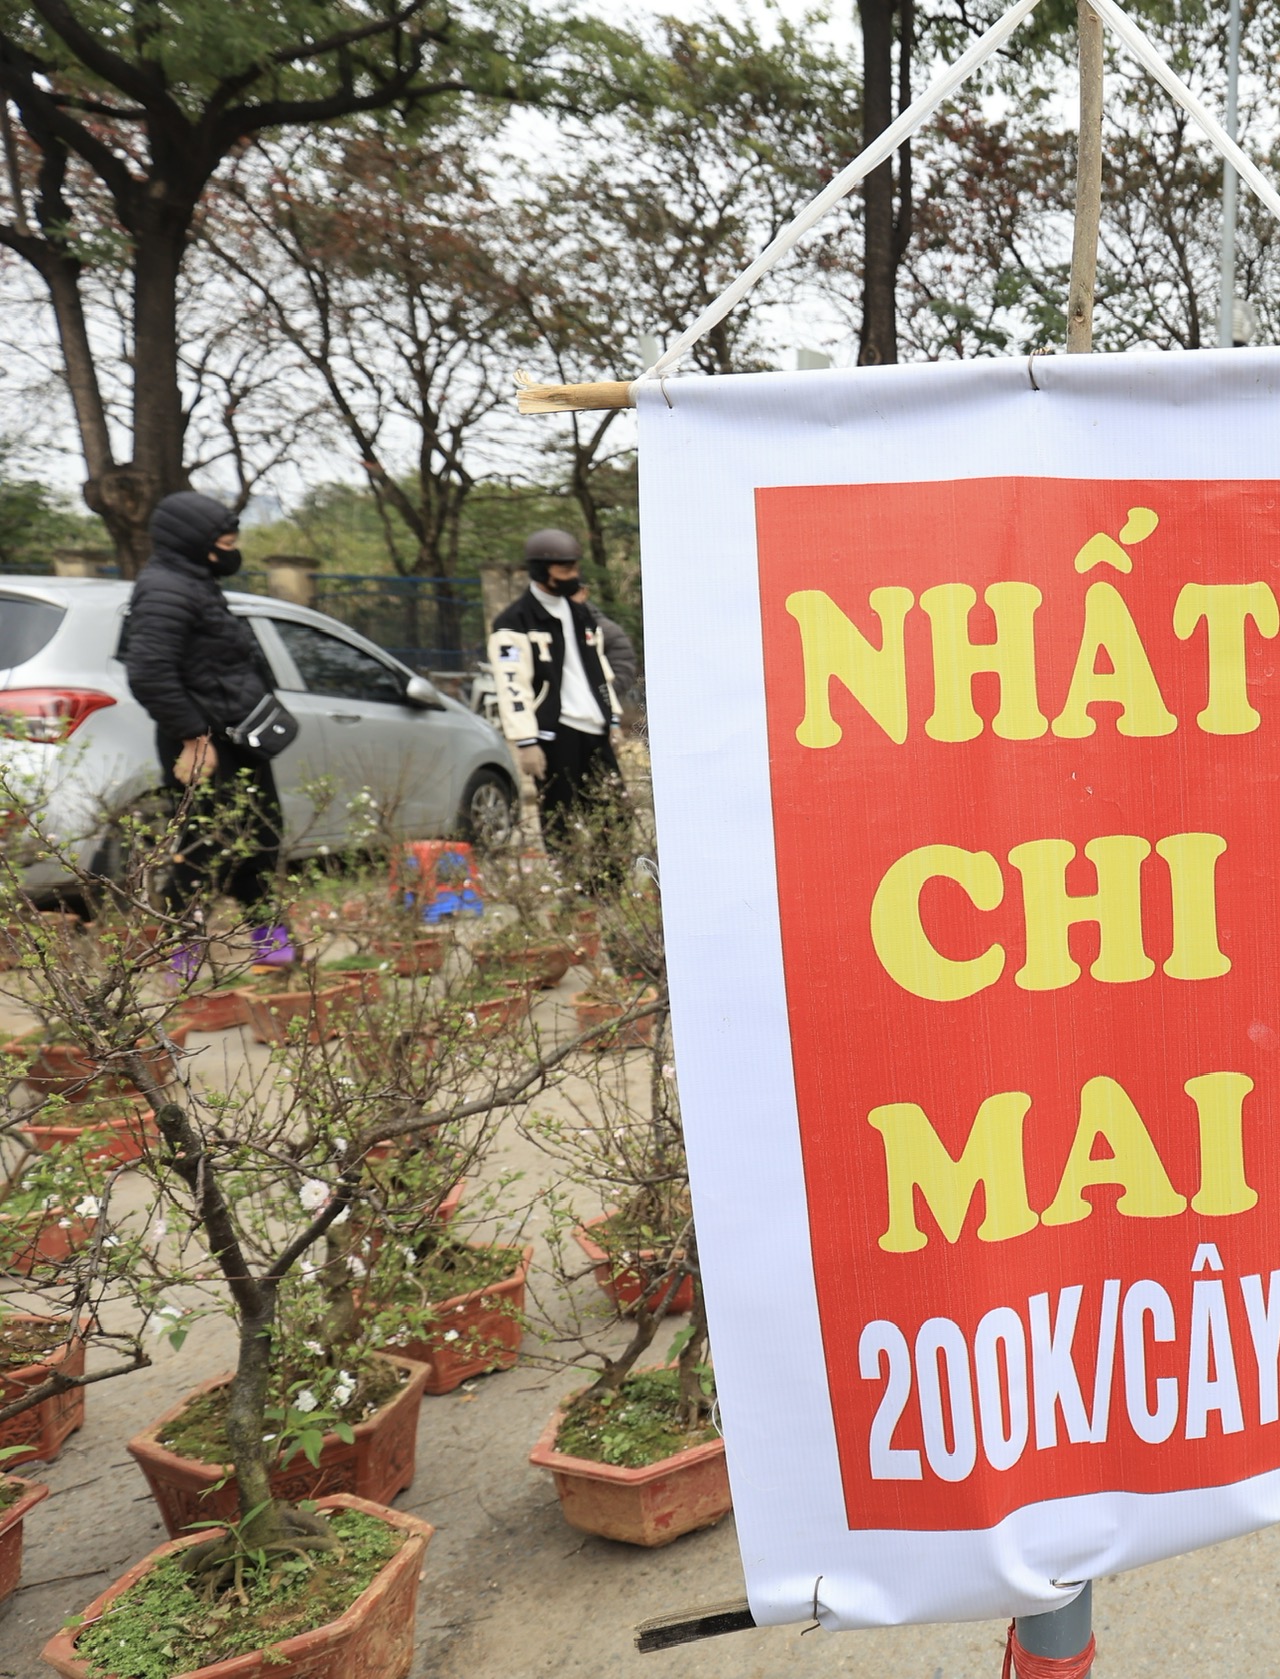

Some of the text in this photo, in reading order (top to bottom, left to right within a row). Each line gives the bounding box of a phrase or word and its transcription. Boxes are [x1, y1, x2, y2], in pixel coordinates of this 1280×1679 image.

[785, 507, 1280, 749] NHẤT
[870, 832, 1232, 1002] CHI
[867, 1071, 1259, 1253] MAI
